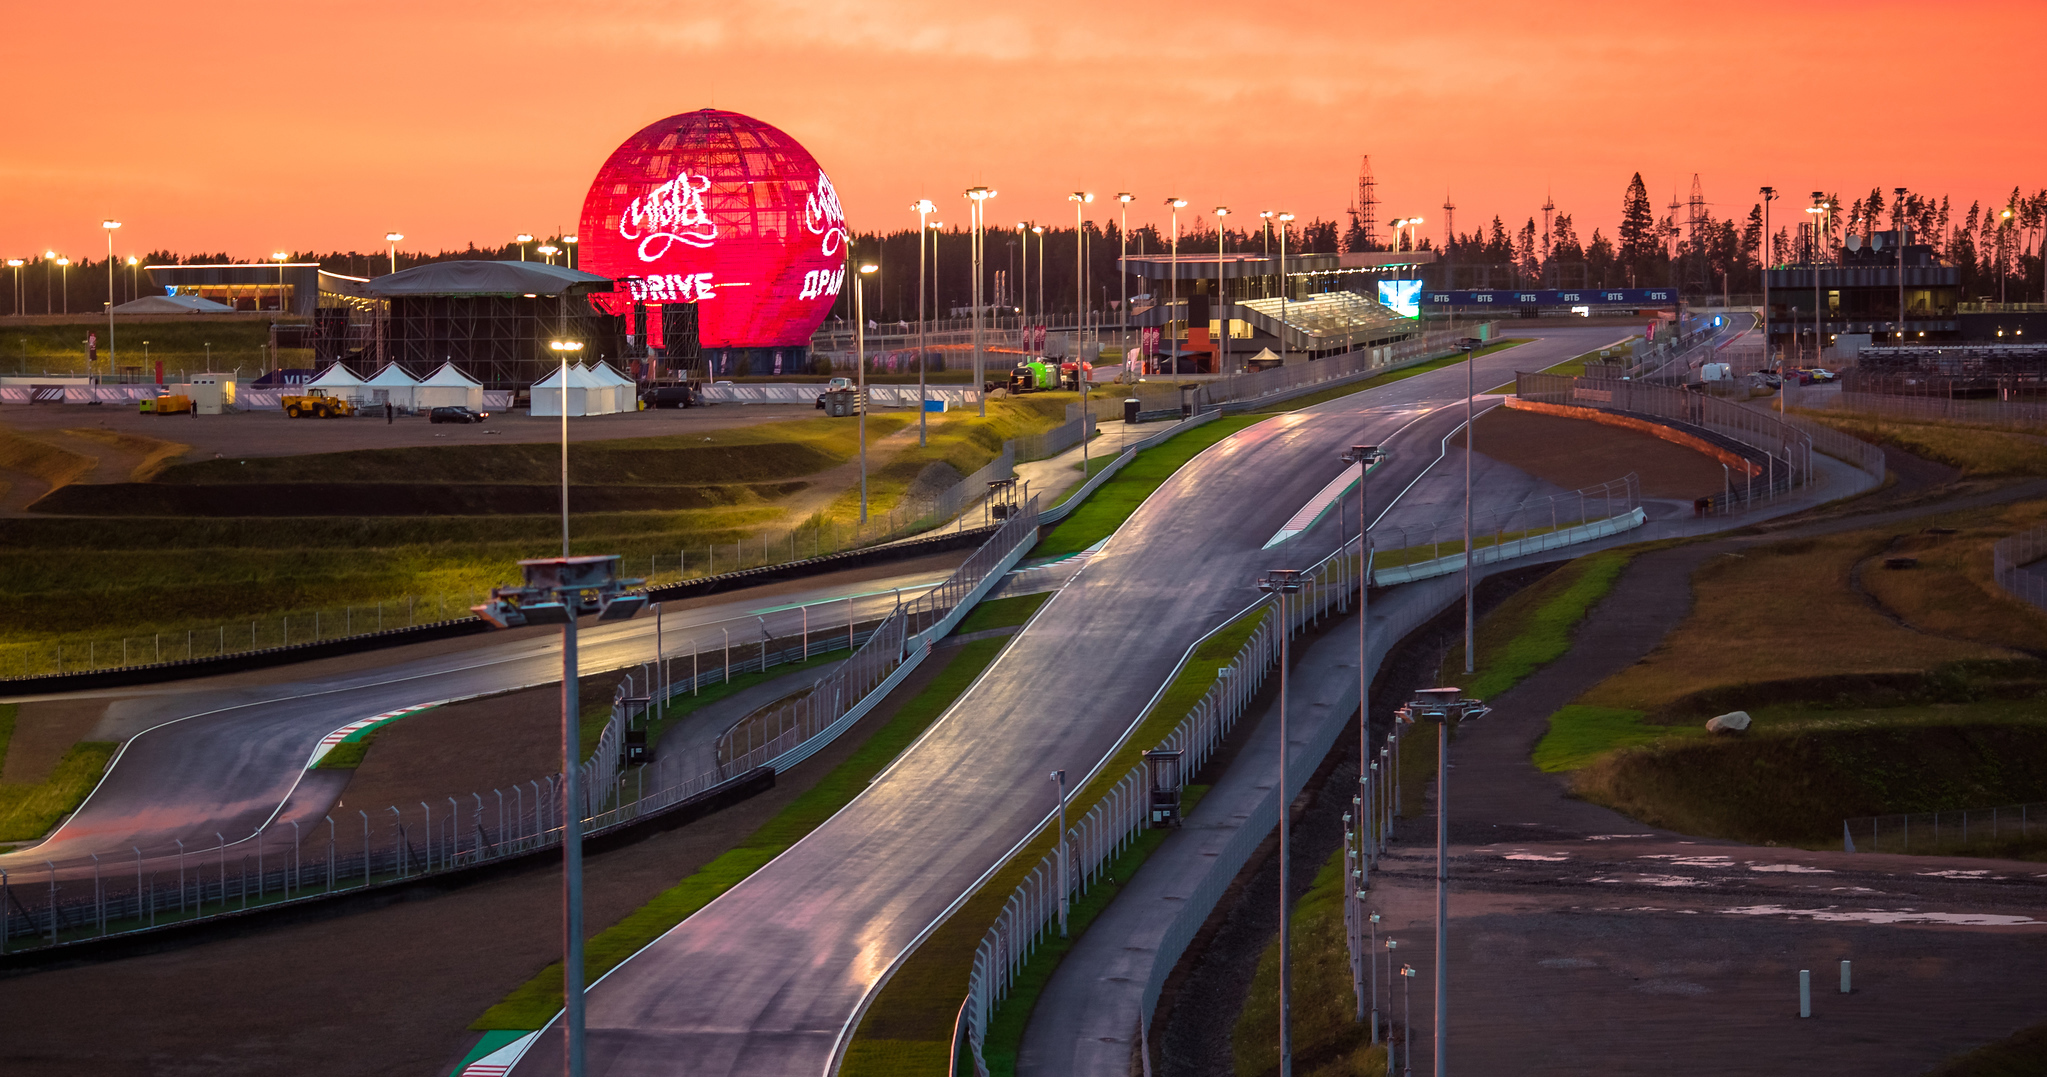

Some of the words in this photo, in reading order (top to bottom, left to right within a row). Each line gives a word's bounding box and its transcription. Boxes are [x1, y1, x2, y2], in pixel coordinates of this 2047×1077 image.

[627, 272, 717, 301] DRIVE
[1433, 294, 1450, 303] ВТБ
[1477, 294, 1493, 303] ВТБ
[1520, 294, 1537, 302] ВТБ
[1563, 293, 1580, 302] ВТБ
[1607, 292, 1624, 301] ВТБ
[1651, 292, 1667, 300] ВТБ
